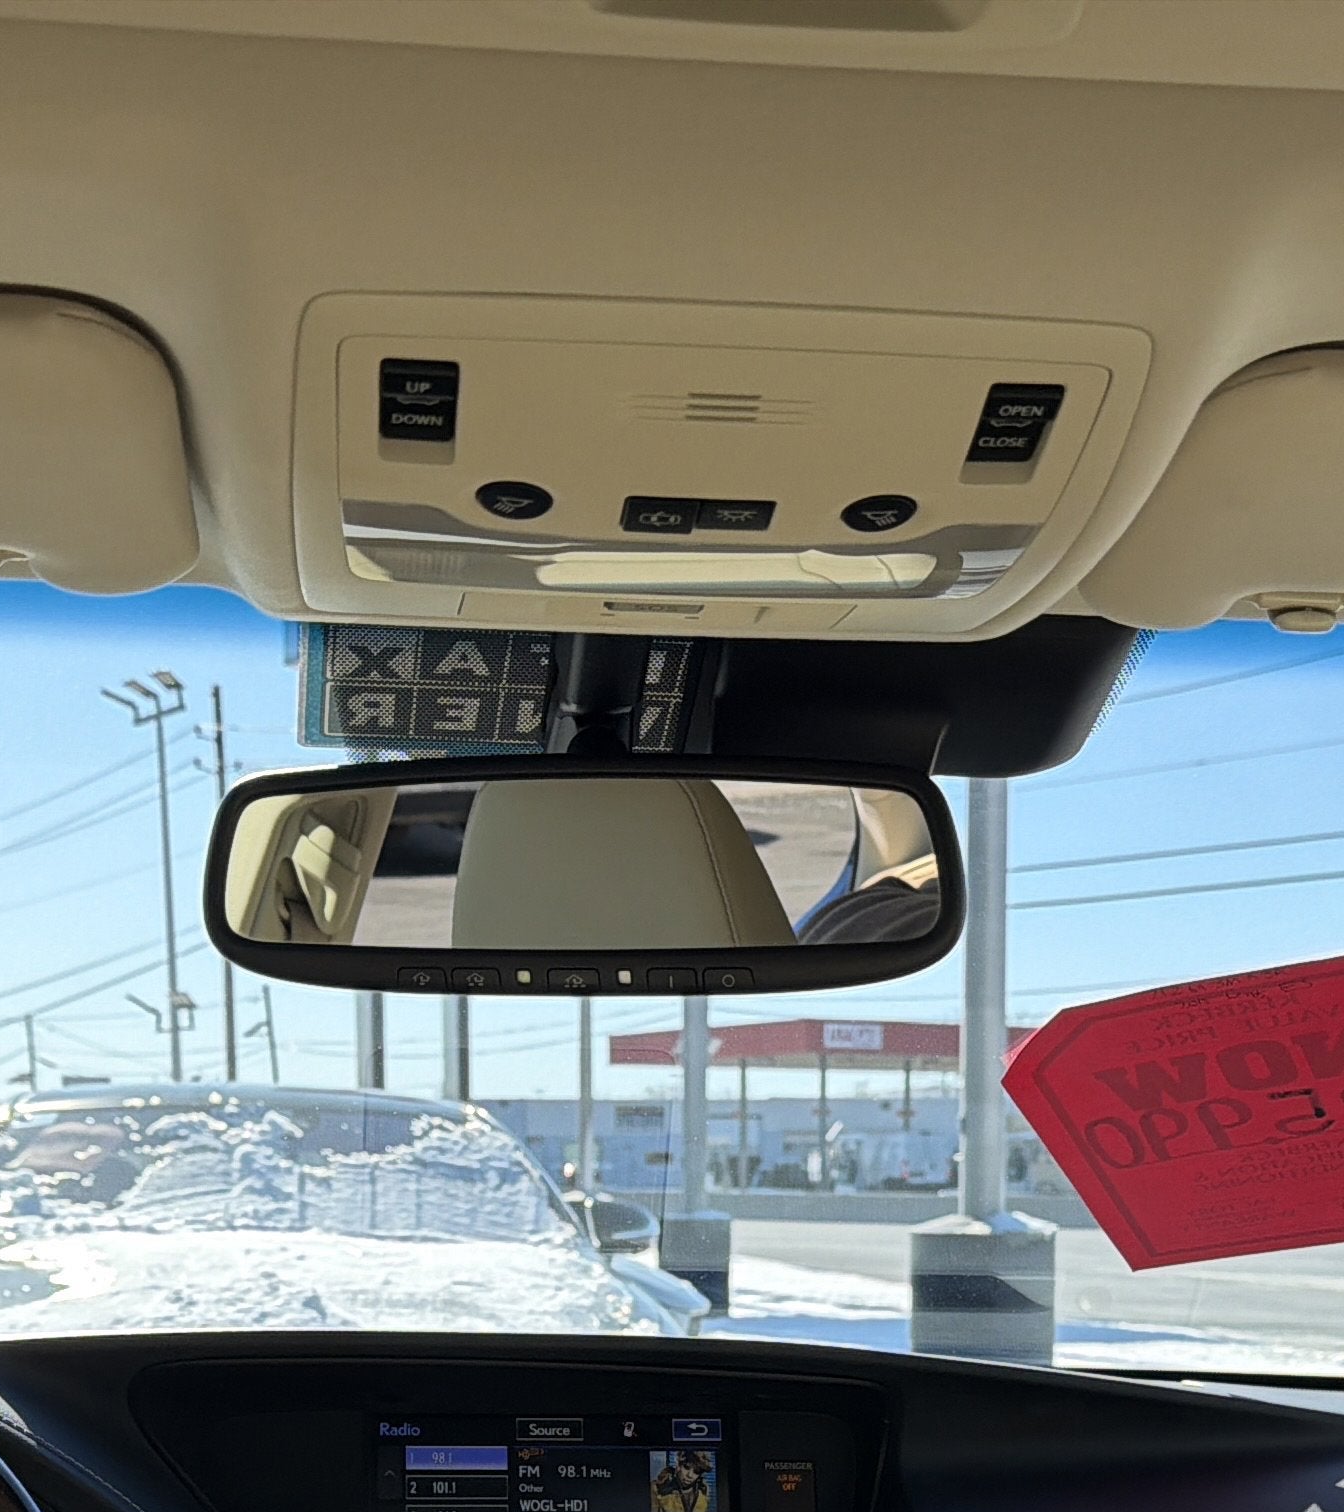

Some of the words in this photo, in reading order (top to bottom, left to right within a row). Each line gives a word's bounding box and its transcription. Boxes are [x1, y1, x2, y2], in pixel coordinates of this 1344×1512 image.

[405, 381, 432, 393] UP
[998, 405, 1044, 417] OPEN
[391, 413, 444, 426] DOWN
[978, 437, 1028, 448] CLOSE
[379, 1422, 421, 1436] Radio
[528, 1423, 571, 1436] Source
[518, 1465, 540, 1478] FM
[557, 1465, 587, 1478] 98.1
[590, 1468, 611, 1478] MHz
[764, 1462, 813, 1471] PASSENGER
[409, 1481, 417, 1494] 2
[432, 1481, 456, 1494] 101.1
[518, 1484, 544, 1493] Other
[519, 1499, 589, 1512] WOGL-HD1
